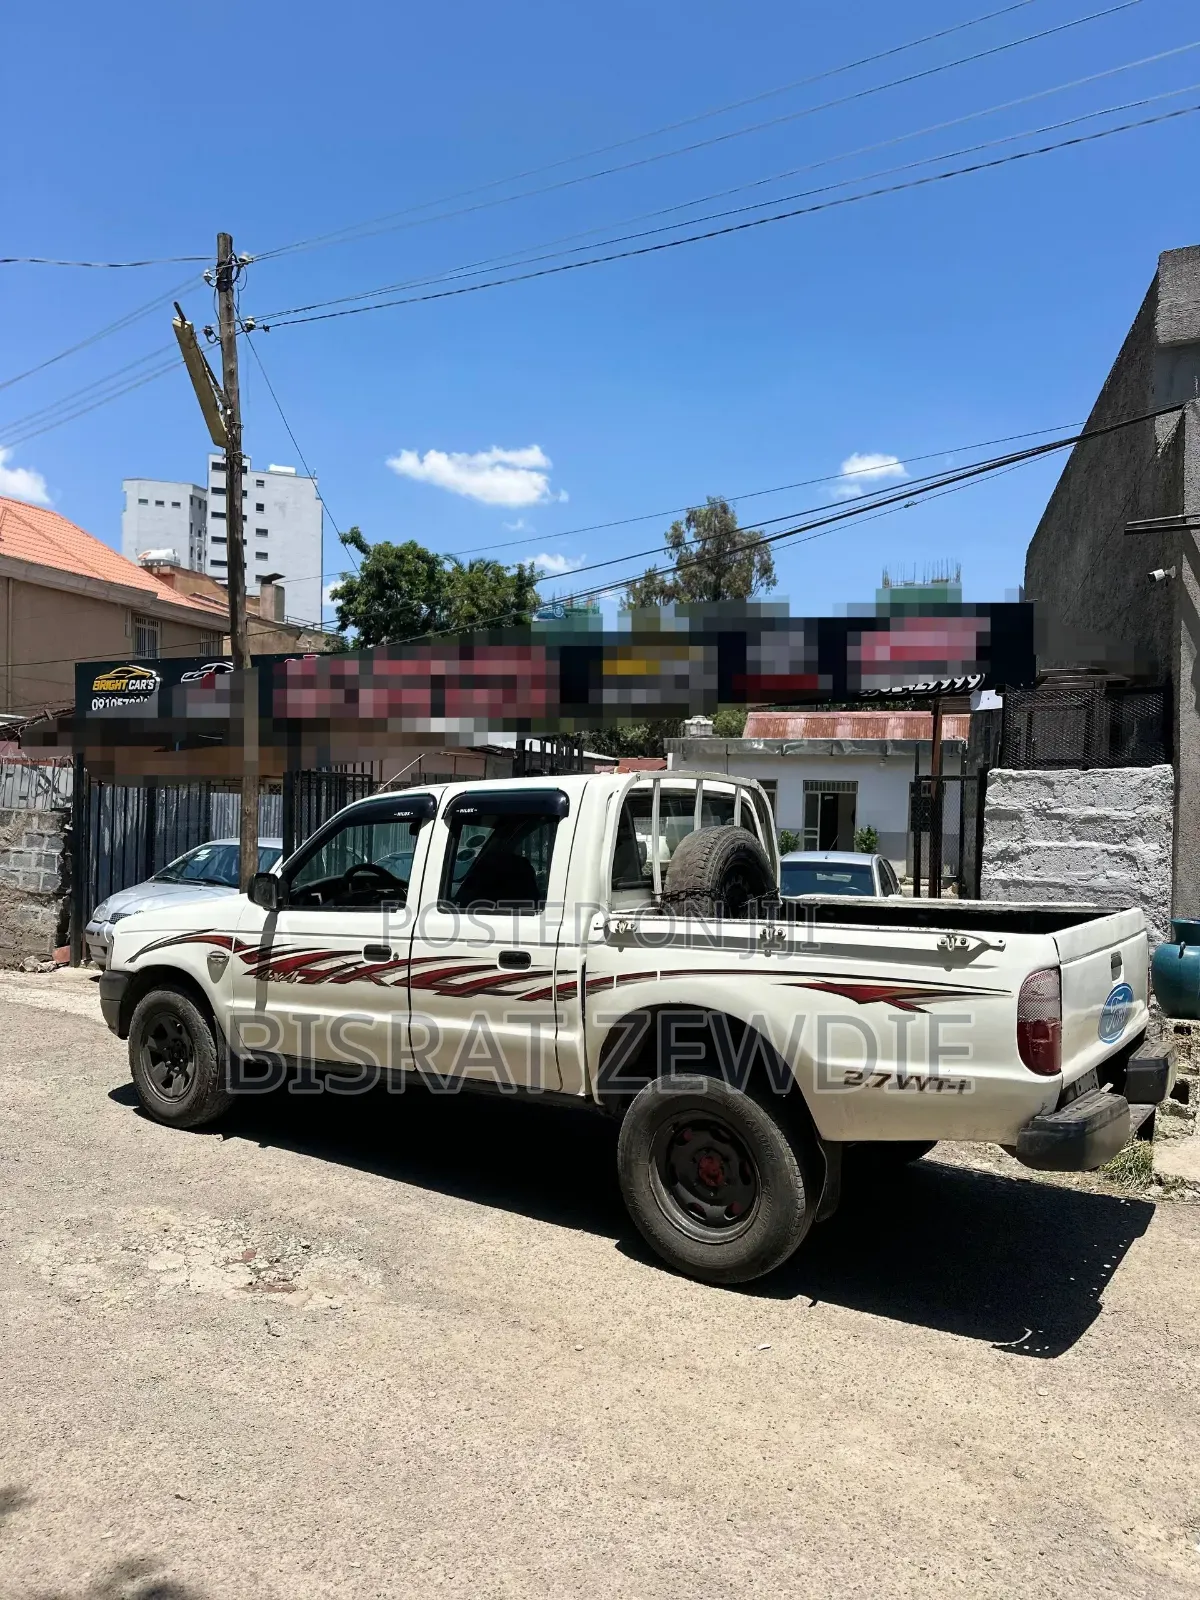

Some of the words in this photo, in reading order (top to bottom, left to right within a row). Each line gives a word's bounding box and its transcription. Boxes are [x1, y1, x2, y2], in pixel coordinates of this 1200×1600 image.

[92, 679, 128, 691] BRIGHT
[128, 679, 155, 690] CAR'S
[843, 1070, 892, 1089] 2.7
